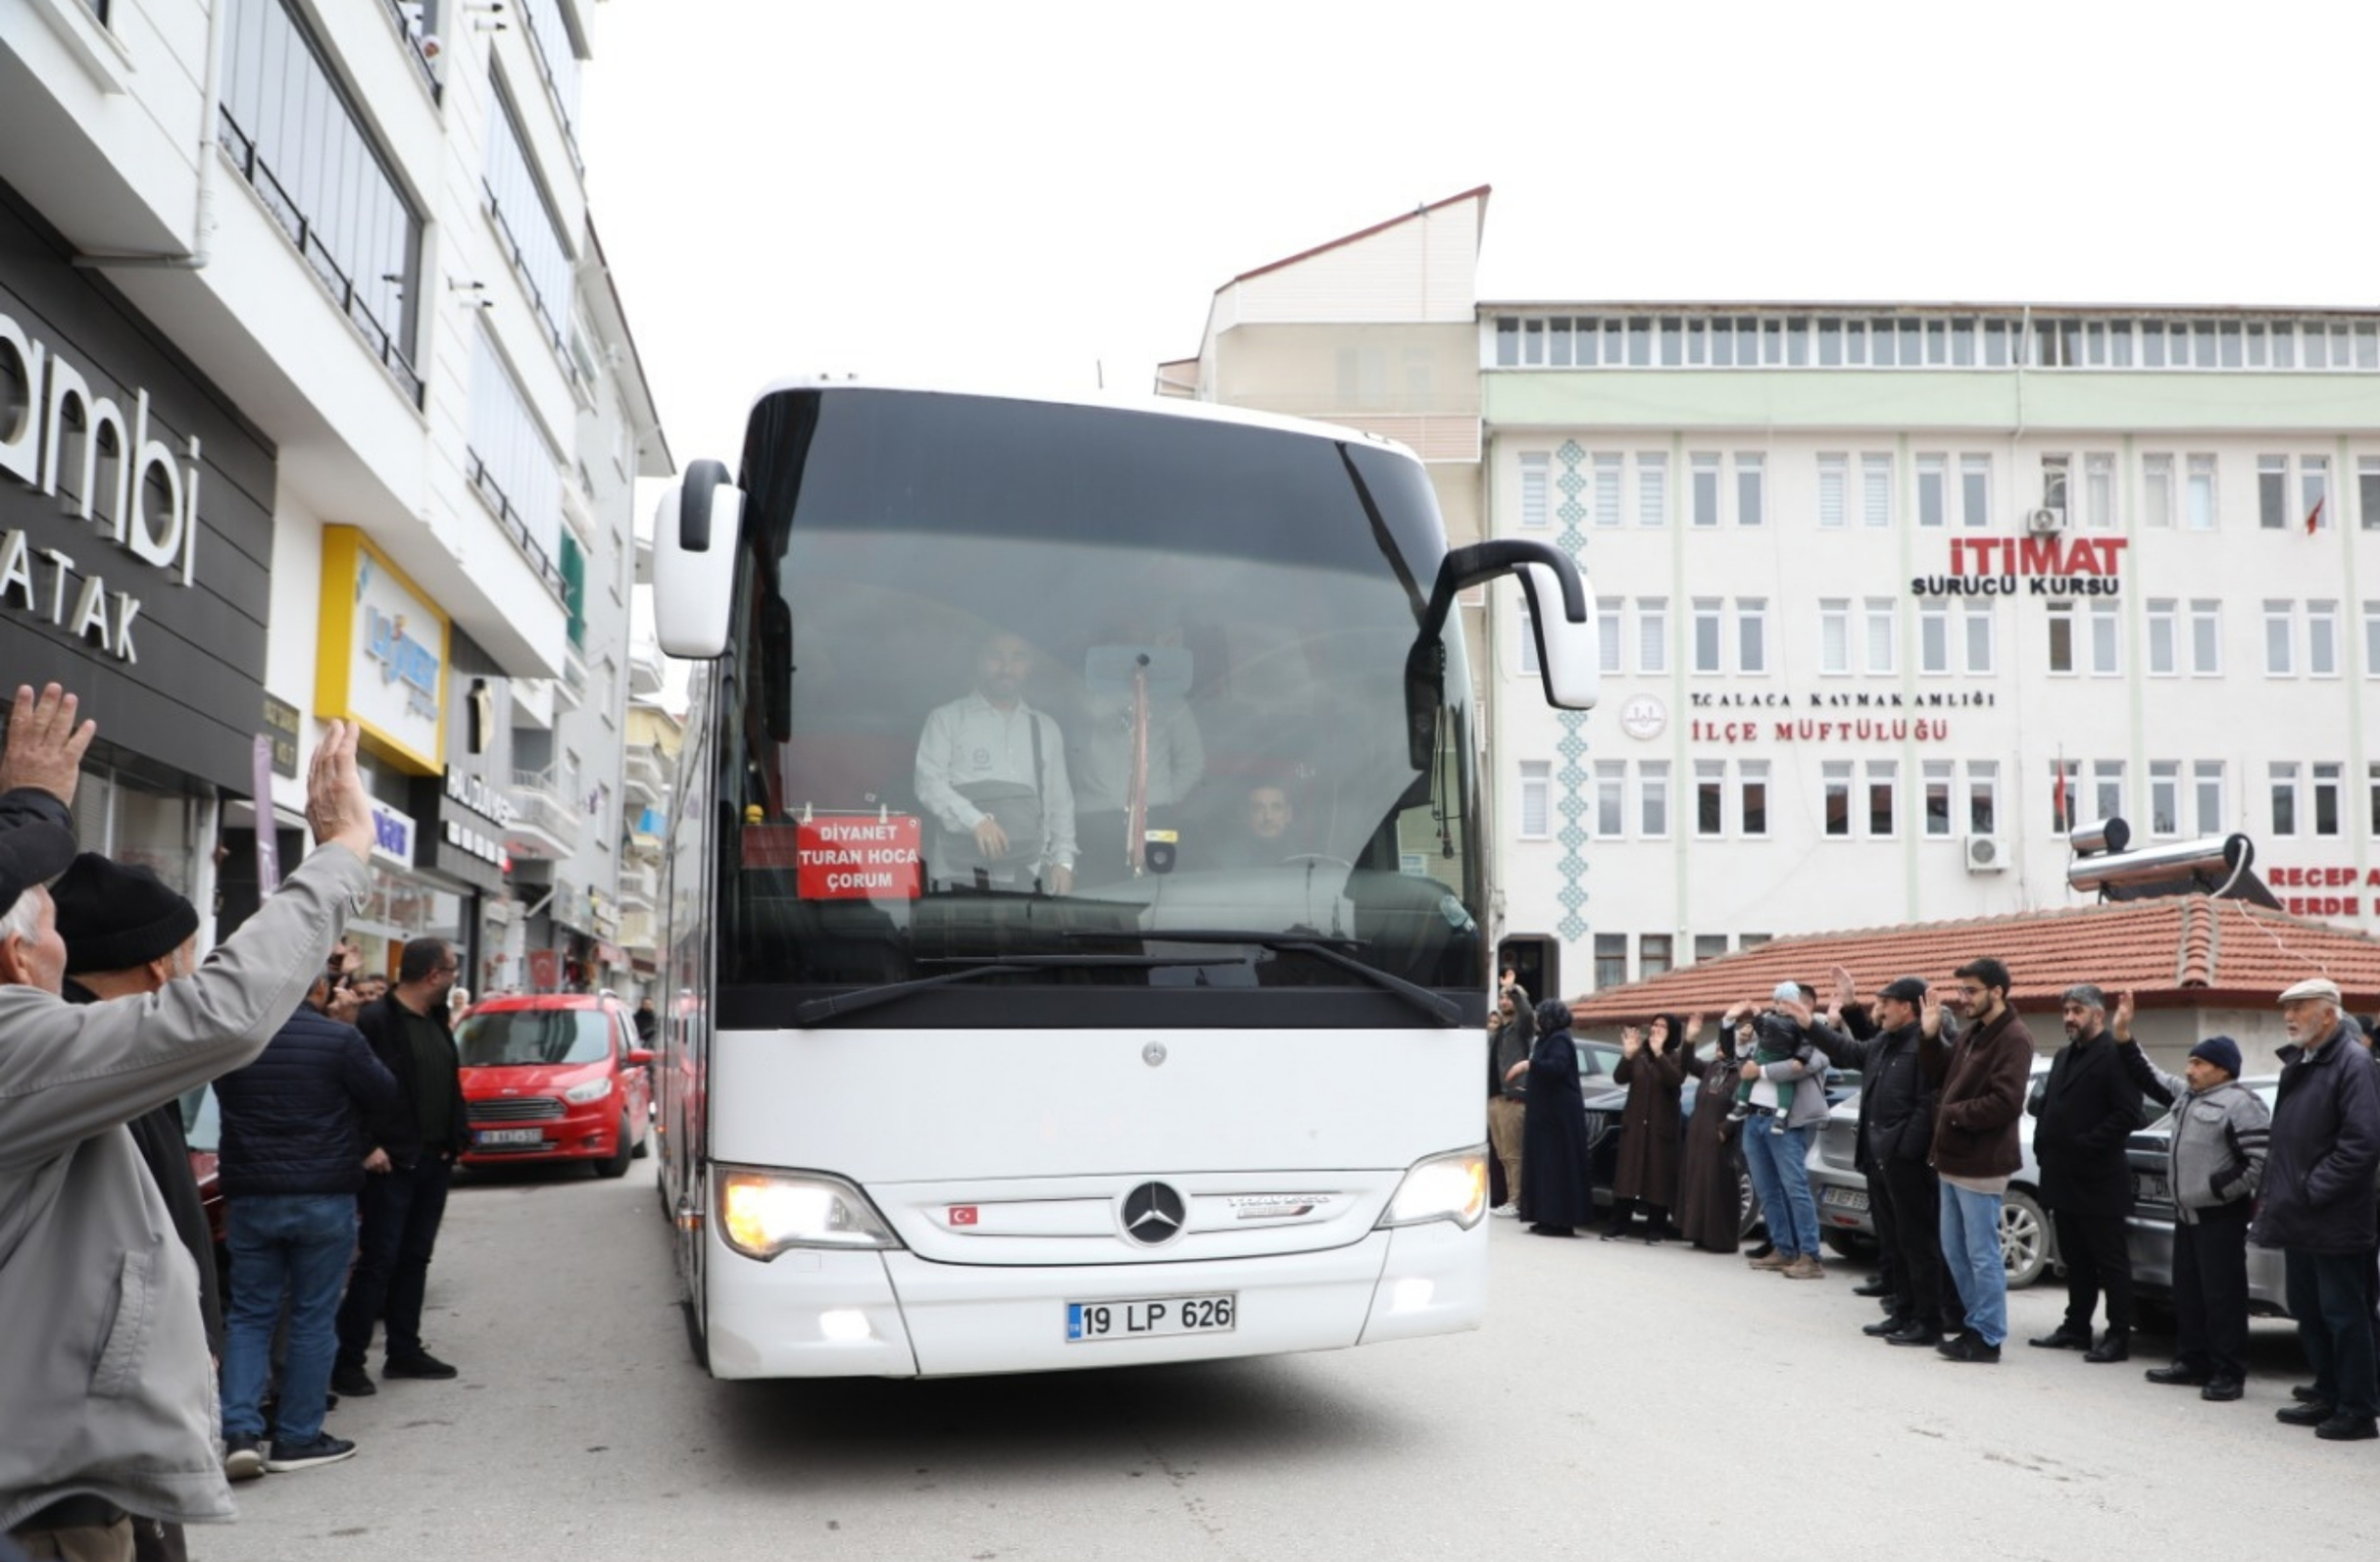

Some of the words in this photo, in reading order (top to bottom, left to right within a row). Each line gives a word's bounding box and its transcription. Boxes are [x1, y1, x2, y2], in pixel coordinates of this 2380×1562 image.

[2030, 577, 2119, 595] KURSU
[1691, 718, 1758, 744] İLÇE
[820, 823, 898, 841] DİYANET
[800, 849, 863, 866] TURAN
[868, 848, 919, 865] HOCA
[826, 872, 893, 893] ÇORUM
[2268, 867, 2358, 886] RECEP
[1083, 1306, 1112, 1335] 19
[1127, 1303, 1166, 1332] LP
[1181, 1298, 1231, 1328] 626
